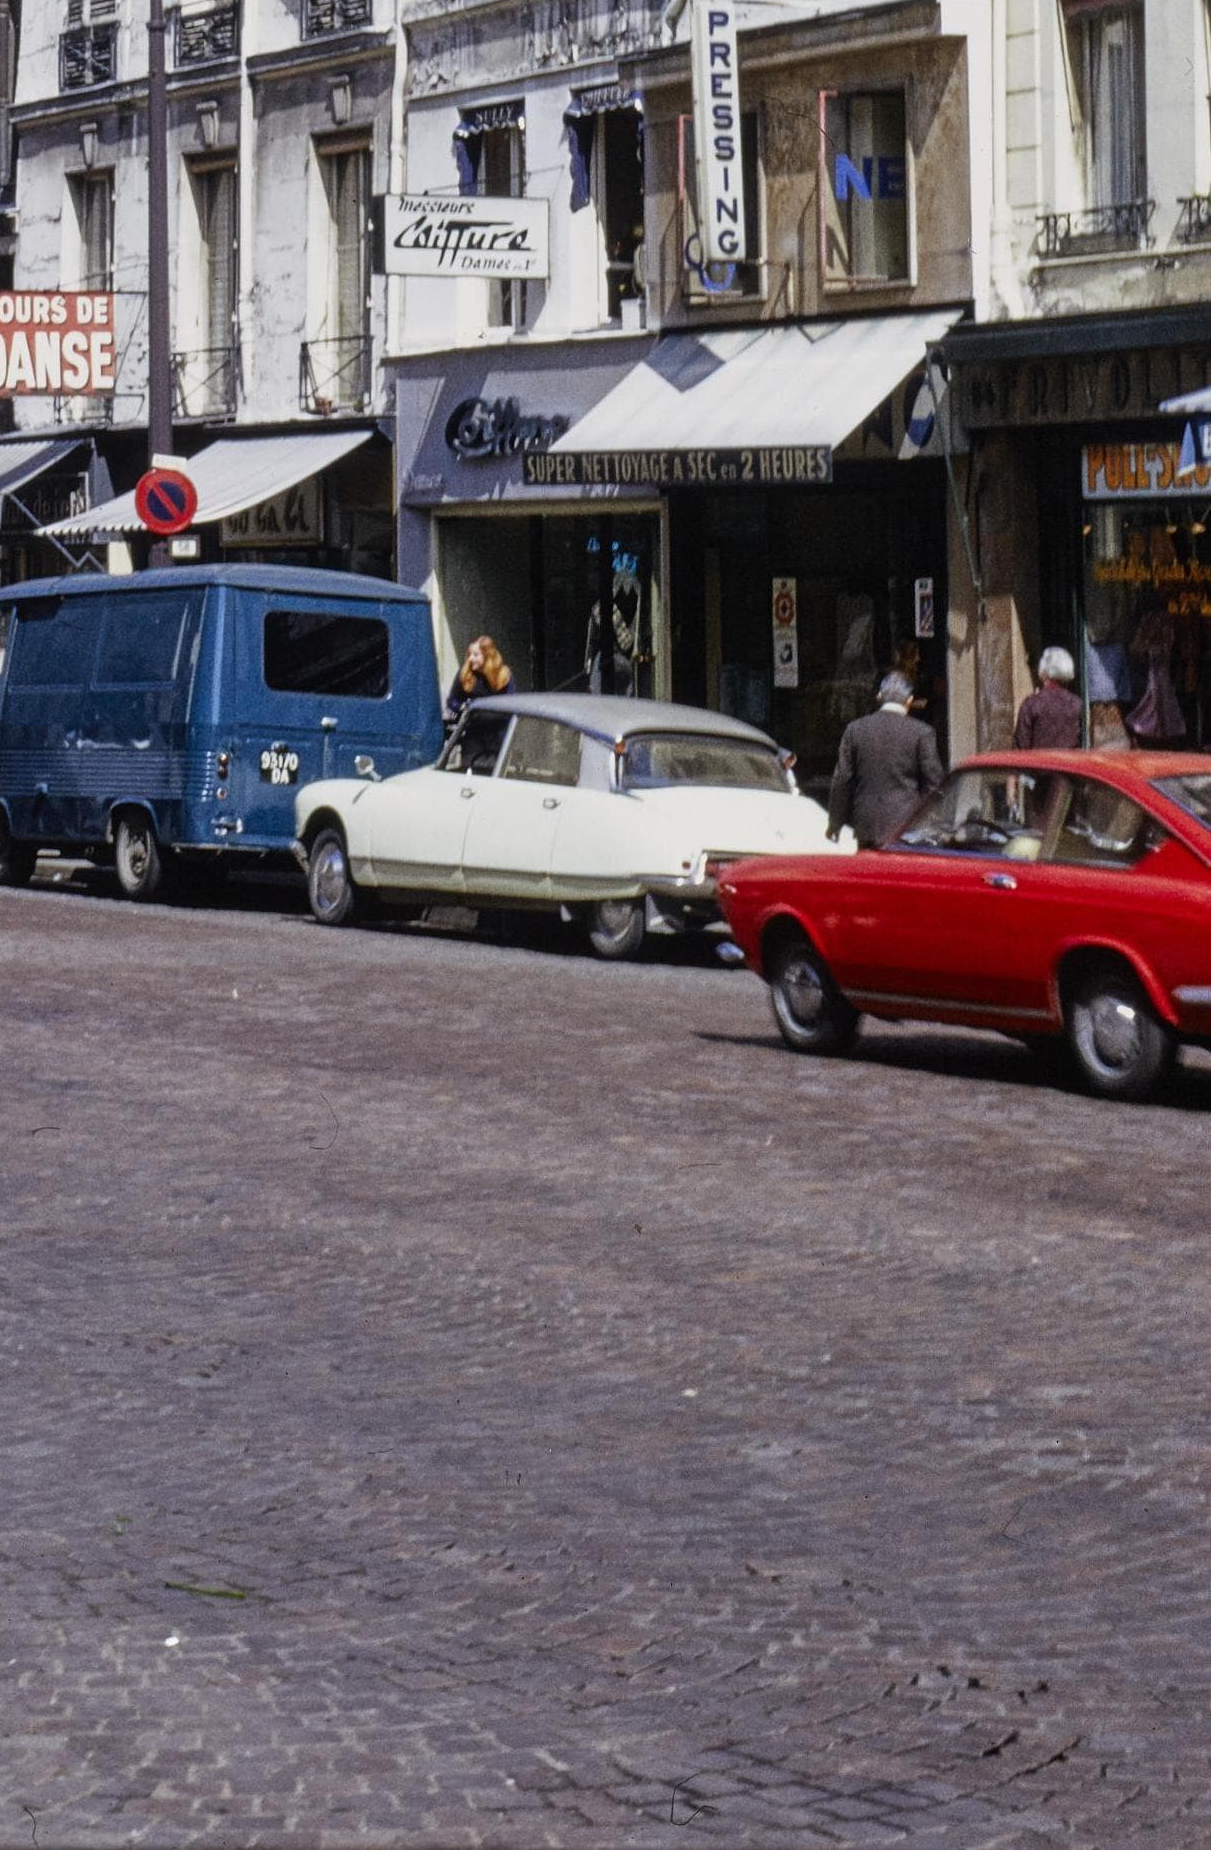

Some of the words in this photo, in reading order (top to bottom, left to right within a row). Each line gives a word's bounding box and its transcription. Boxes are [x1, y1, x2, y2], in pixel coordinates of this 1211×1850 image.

[709, 11, 739, 256] PRESSING
[393, 215, 535, 268] Coiffure
[77, 296, 108, 324] DE
[527, 454, 576, 482] SUPER
[581, 452, 669, 482] NETTOYAGE
[673, 455, 683, 480] A
[687, 450, 717, 481] SEC
[721, 463, 737, 480] en
[740, 451, 754, 480] 2
[759, 449, 827, 480] HEURES
